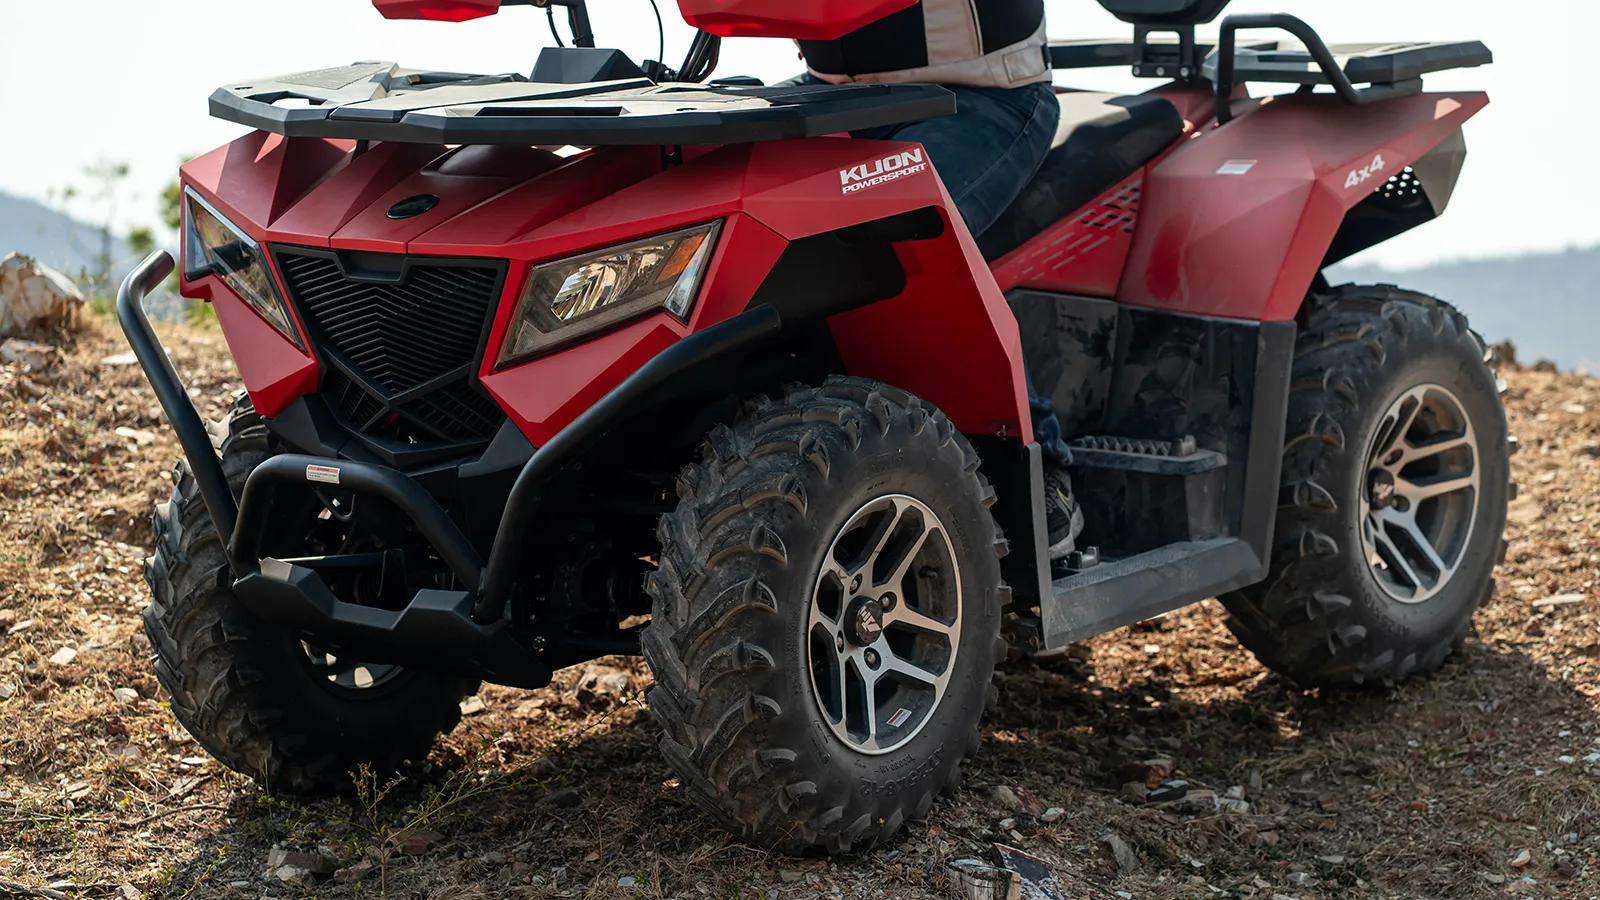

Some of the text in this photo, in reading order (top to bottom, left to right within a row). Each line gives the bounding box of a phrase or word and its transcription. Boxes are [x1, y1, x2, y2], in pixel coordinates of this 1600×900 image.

[839, 148, 923, 185] KLION
[842, 162, 927, 195] POWERSPORT
[1344, 153, 1386, 190] 4x4
